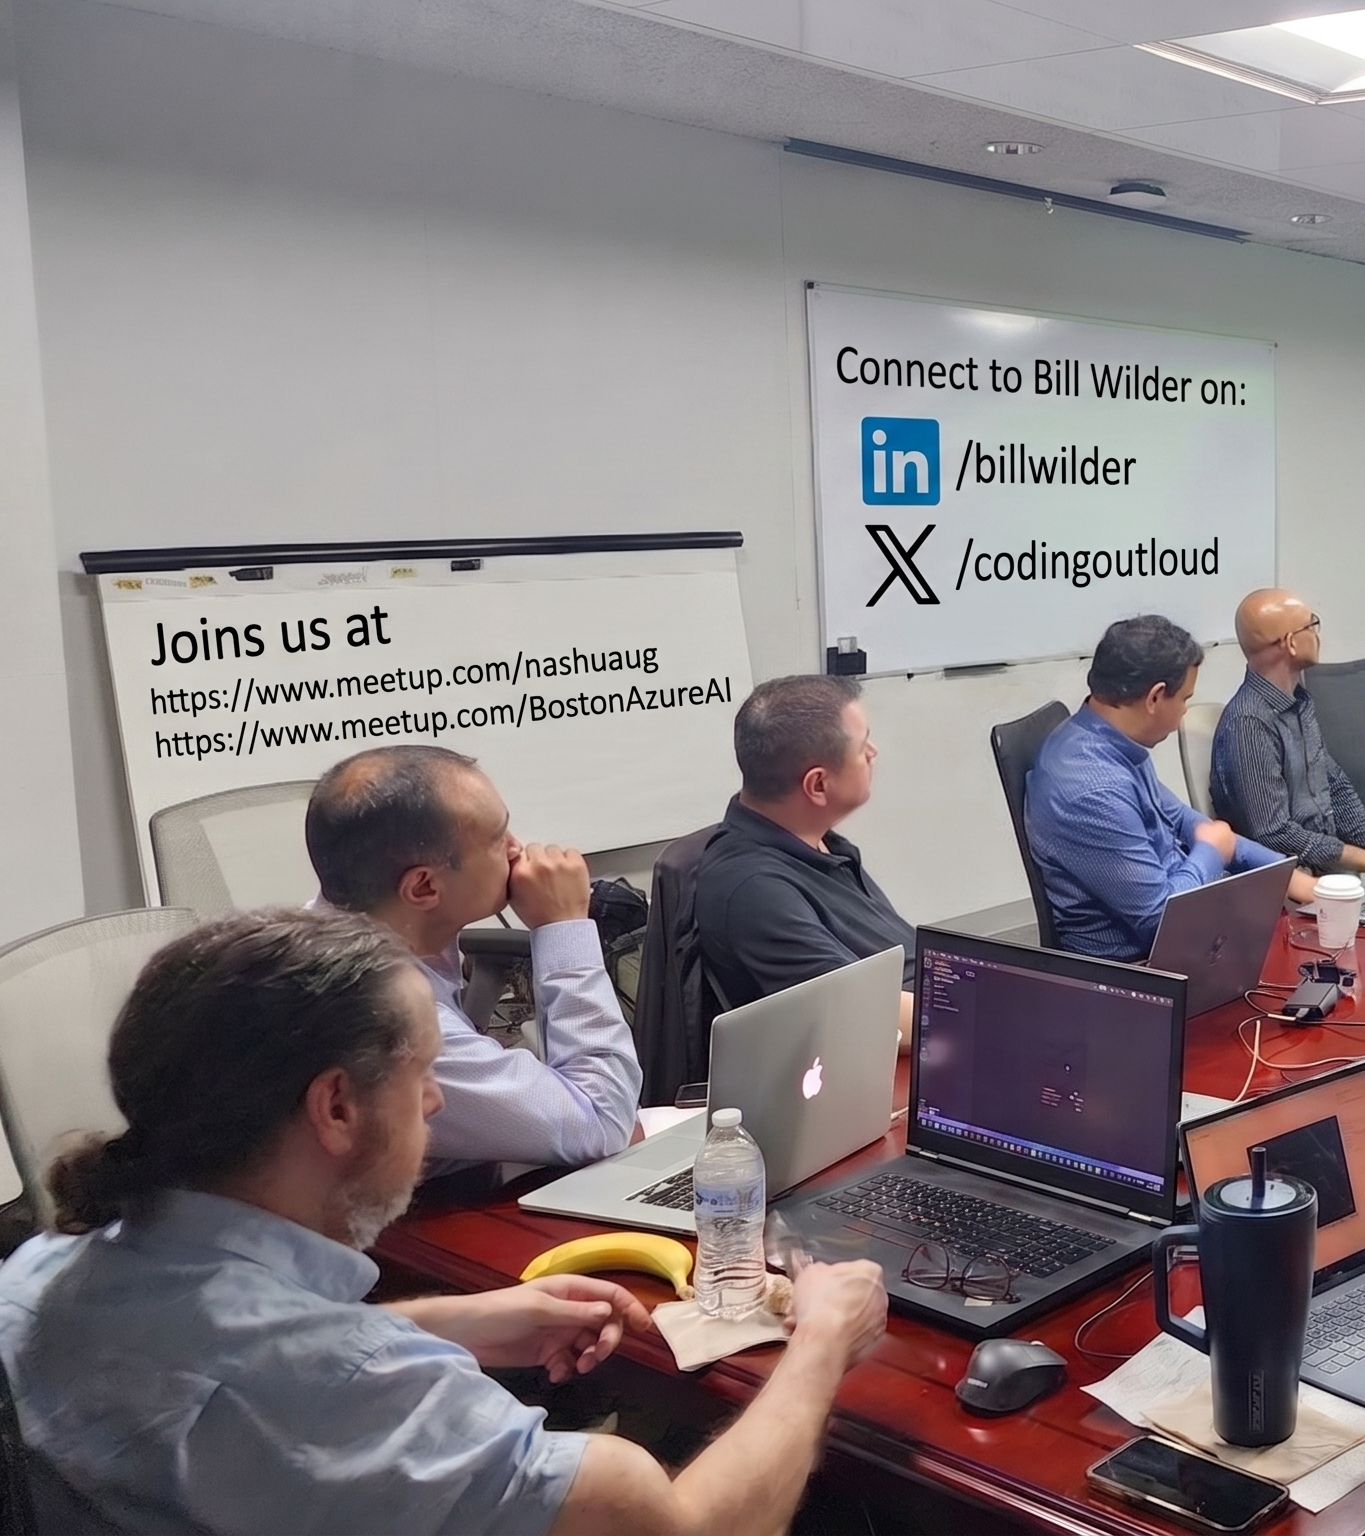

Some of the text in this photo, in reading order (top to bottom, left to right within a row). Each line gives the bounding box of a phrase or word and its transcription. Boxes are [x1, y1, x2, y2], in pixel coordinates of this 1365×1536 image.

[836, 346, 1247, 406] Connect to Bill Wilder on:
[872, 429, 1137, 493] in /billwilder
[864, 524, 1220, 608] X /codingoutloud
[151, 605, 392, 666] Joins us at
[150, 647, 659, 718] https://www.meetup.com/nashuaug
[155, 676, 732, 762] https://www.meetup.com/BostonAzureAI
